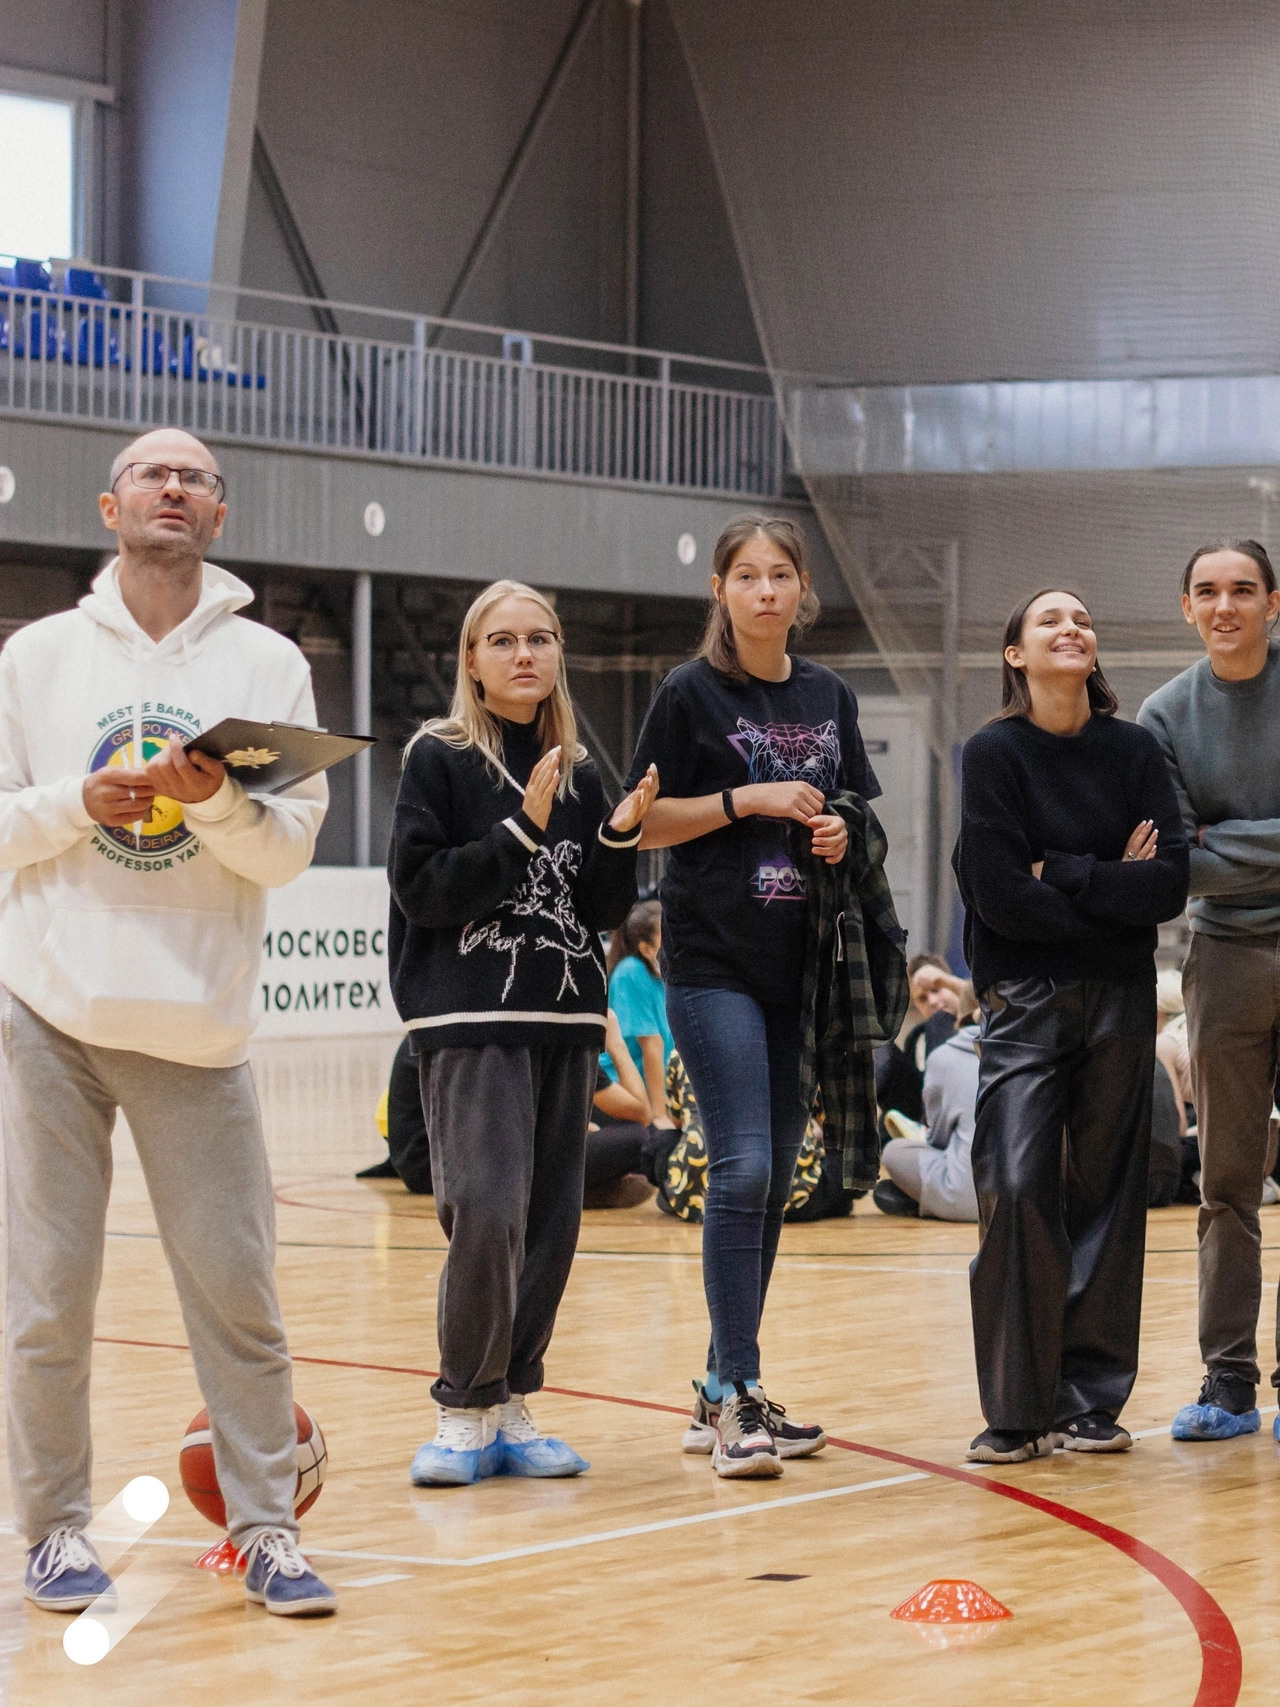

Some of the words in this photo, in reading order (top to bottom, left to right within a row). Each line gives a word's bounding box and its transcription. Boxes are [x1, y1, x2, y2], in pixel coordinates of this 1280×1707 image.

[97, 702, 151, 730] MESTE
[111, 723, 160, 746] GRPO
[90, 836, 173, 871] PROFESSOR
